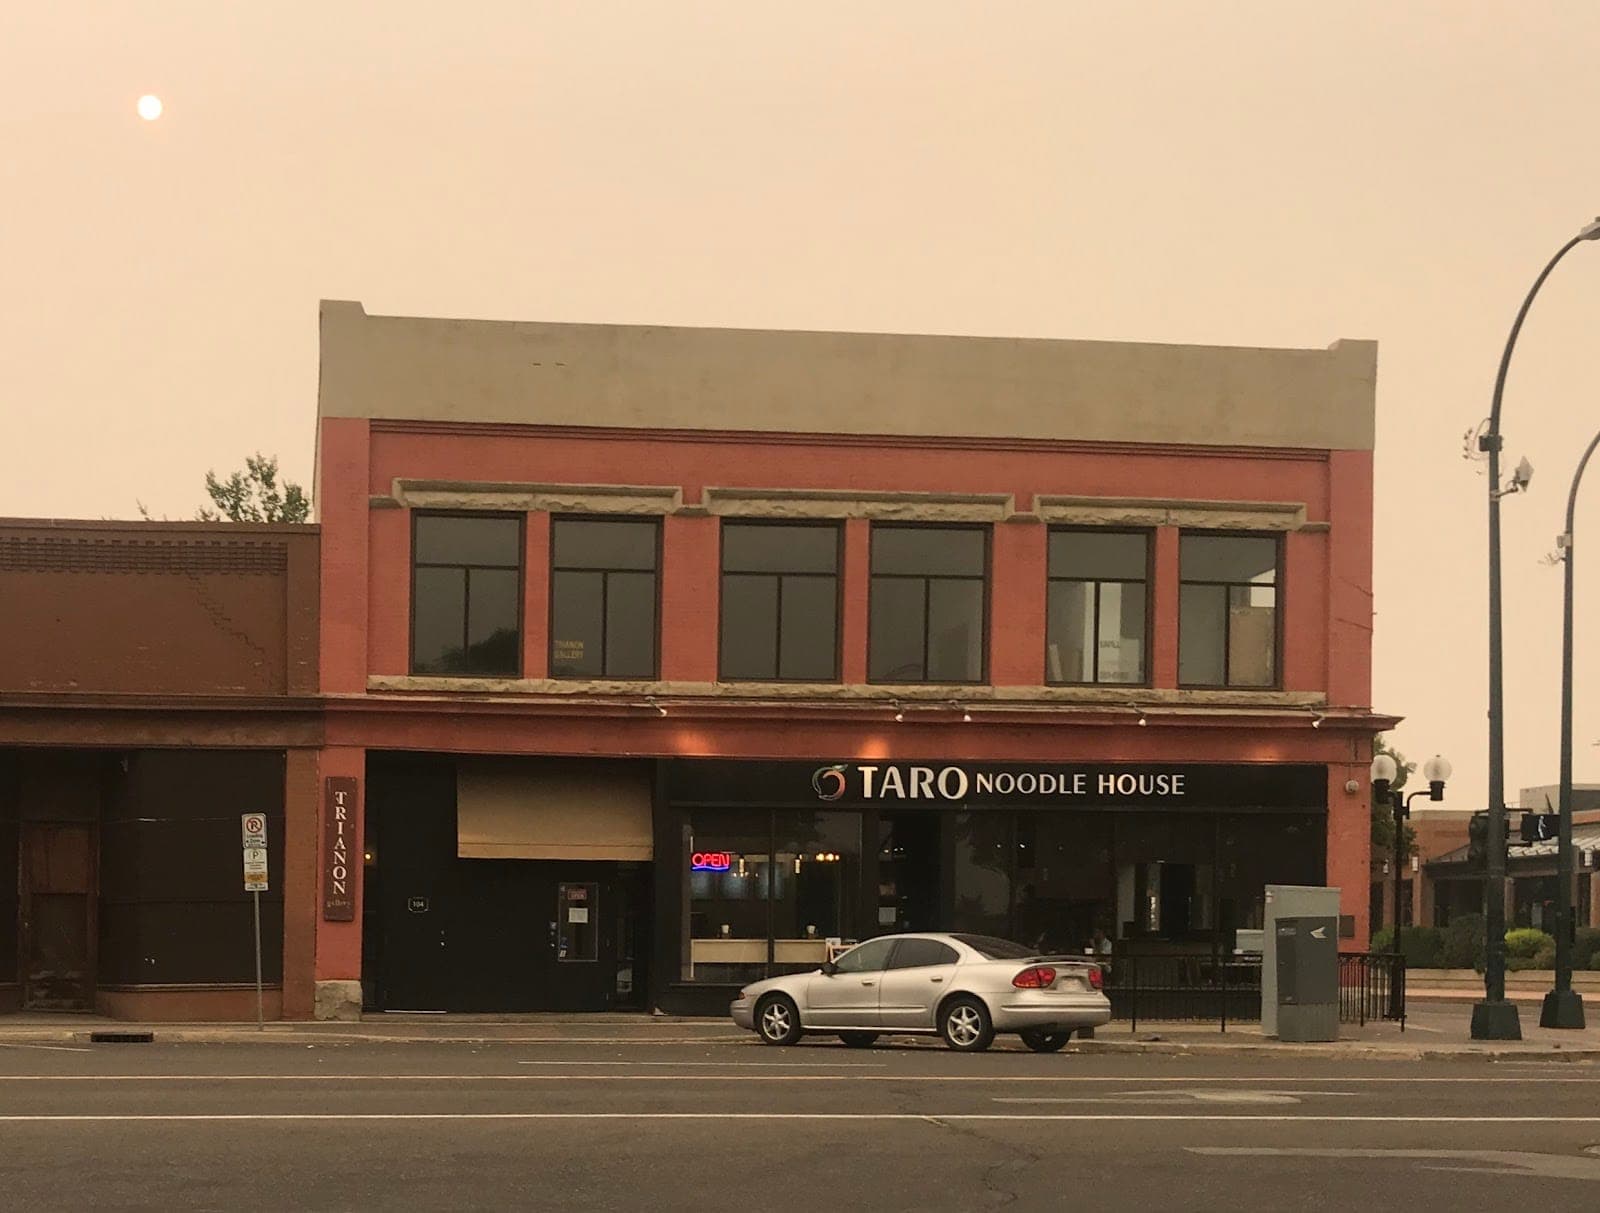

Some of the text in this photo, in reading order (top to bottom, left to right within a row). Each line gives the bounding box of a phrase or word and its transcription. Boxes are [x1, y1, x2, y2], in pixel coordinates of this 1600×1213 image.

[857, 766, 1185, 800] TARO NOODLE HOUSE
[333, 791, 347, 894] TRIANON
[692, 853, 730, 867] OPEN
